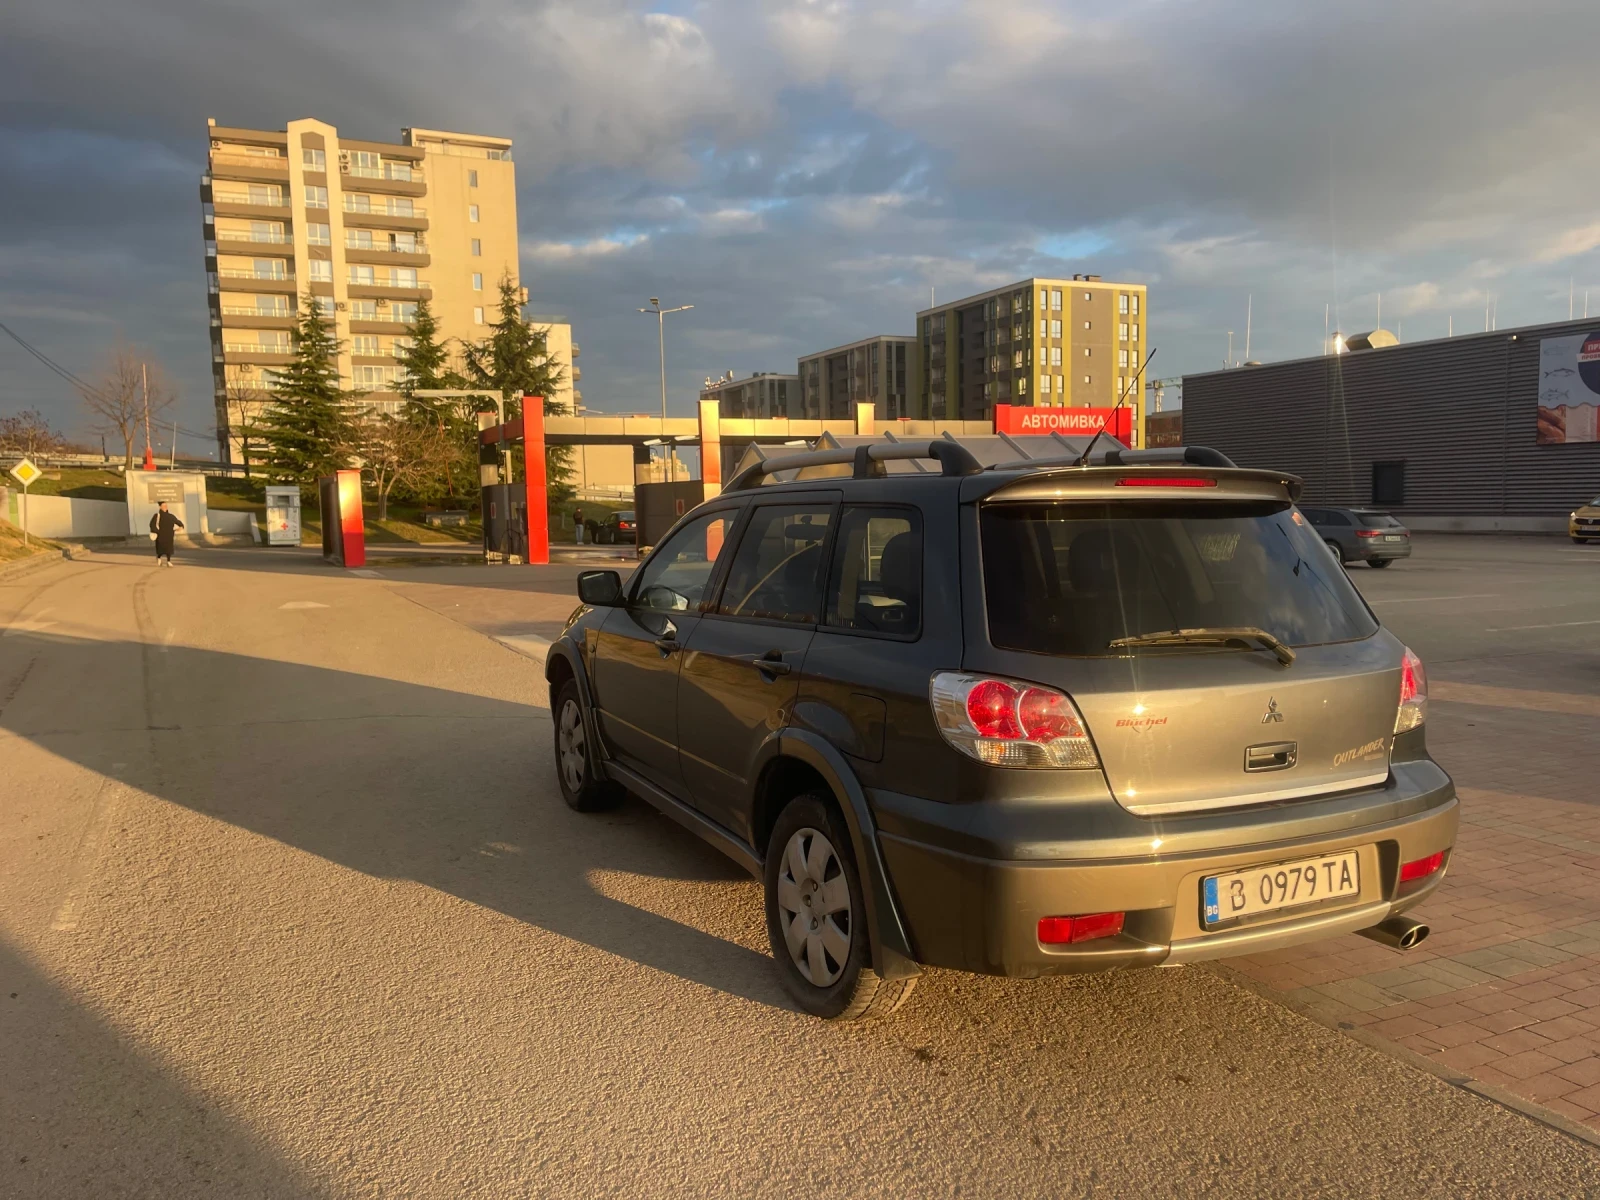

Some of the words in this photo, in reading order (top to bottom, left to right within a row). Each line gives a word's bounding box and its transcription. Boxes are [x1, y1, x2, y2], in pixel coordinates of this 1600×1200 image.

[1021, 414, 1105, 429] АВТОМИВКА
[1333, 737, 1385, 767] OUTLANDER
[1259, 865, 1317, 905] 0979
[1322, 859, 1353, 893] TA
[1206, 905, 1218, 916] BG
